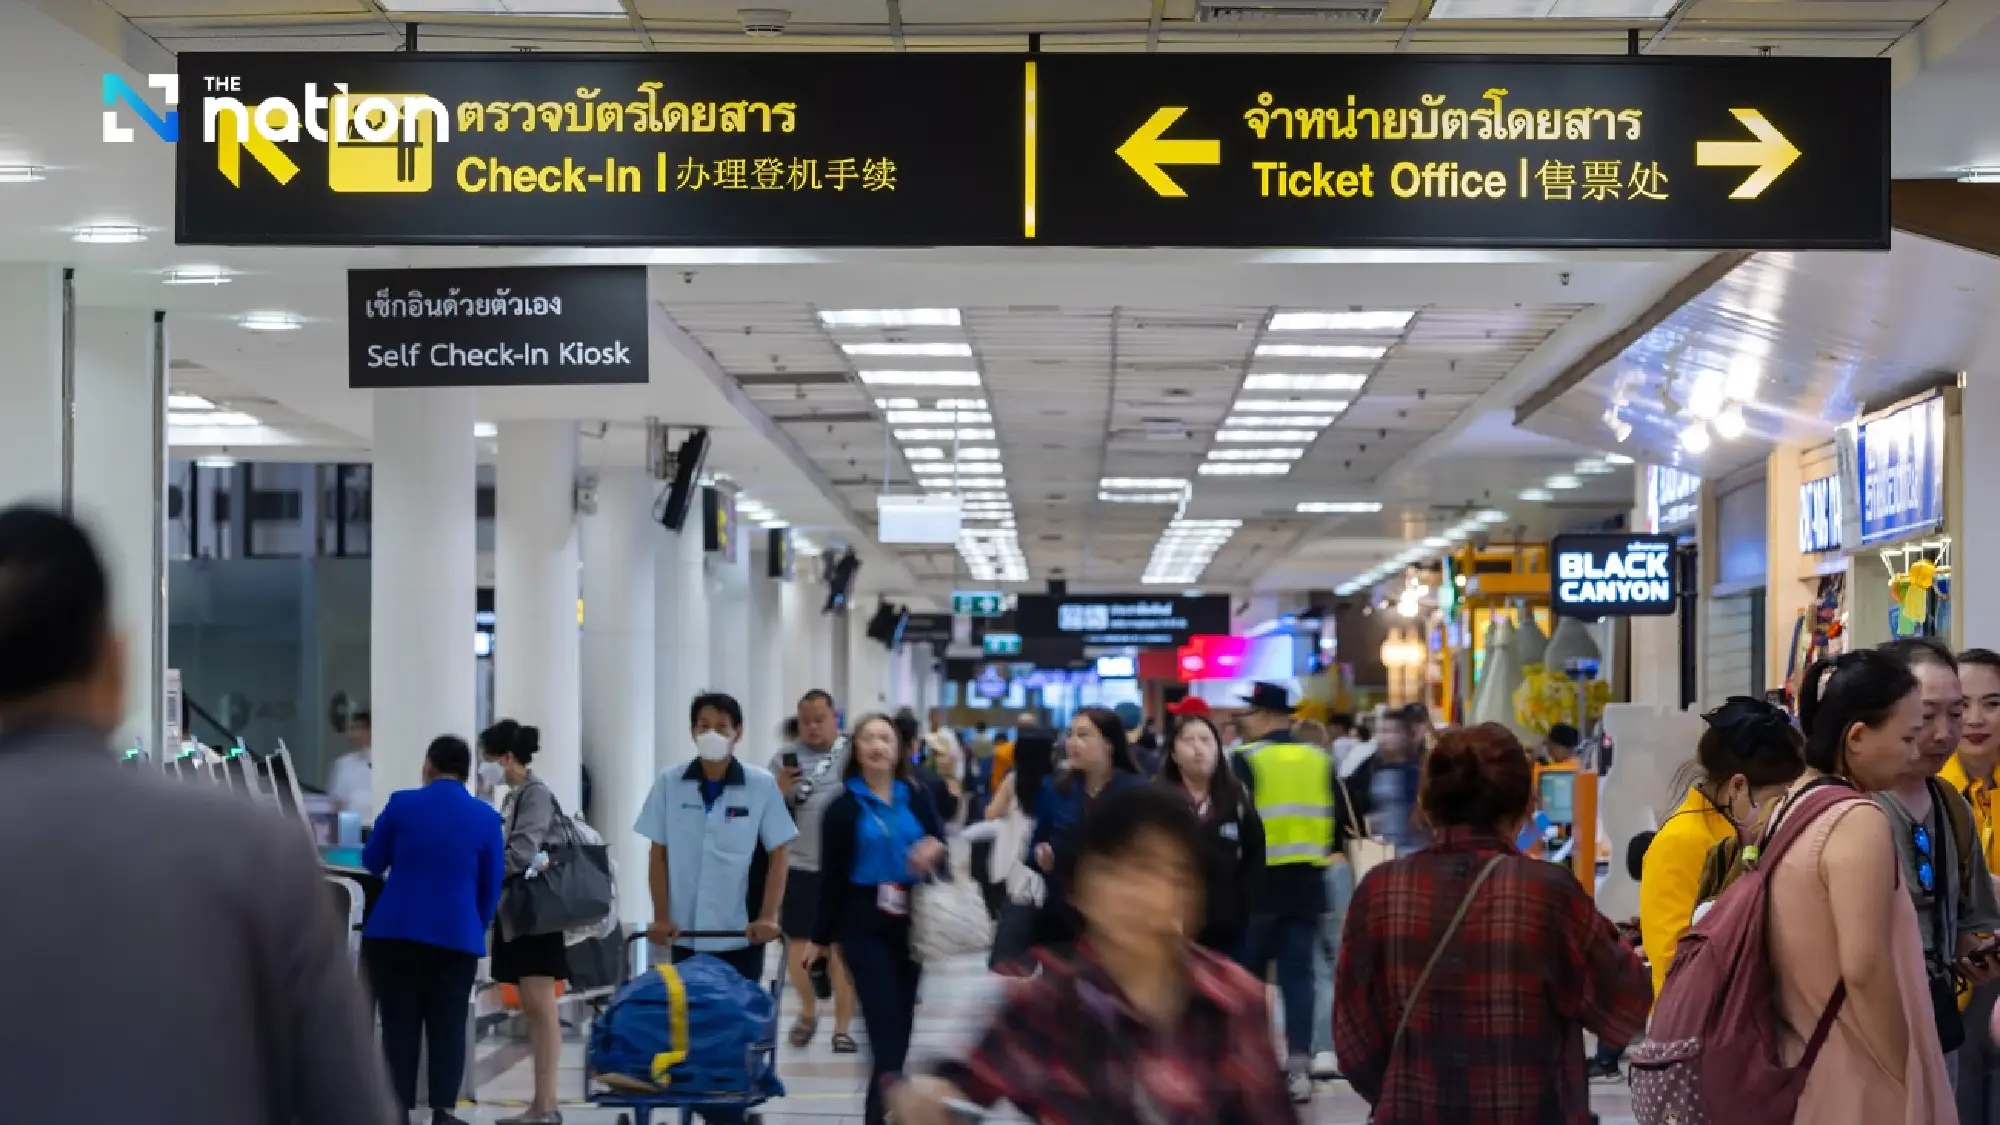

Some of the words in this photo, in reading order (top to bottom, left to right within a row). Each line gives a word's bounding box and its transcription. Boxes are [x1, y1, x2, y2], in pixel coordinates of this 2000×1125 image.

[456, 82, 797, 133] ตรวจบัตรโดยสาร
[1243, 88, 1643, 140] จำหน่ายบัตรโดยสาร
[456, 156, 642, 193] Check-In
[676, 156, 898, 192] 办理登机手续
[1252, 162, 1374, 198] Ticket
[1390, 162, 1507, 198] Office
[1534, 158, 1670, 200] 售票处
[366, 287, 562, 318] เช็กอินด้วยตัวเอง
[367, 343, 422, 367] Self
[430, 342, 549, 366] Check-In
[559, 340, 631, 365] Kiosk
[1559, 552, 1669, 579] BLACK
[1560, 580, 1669, 602] CANYON
